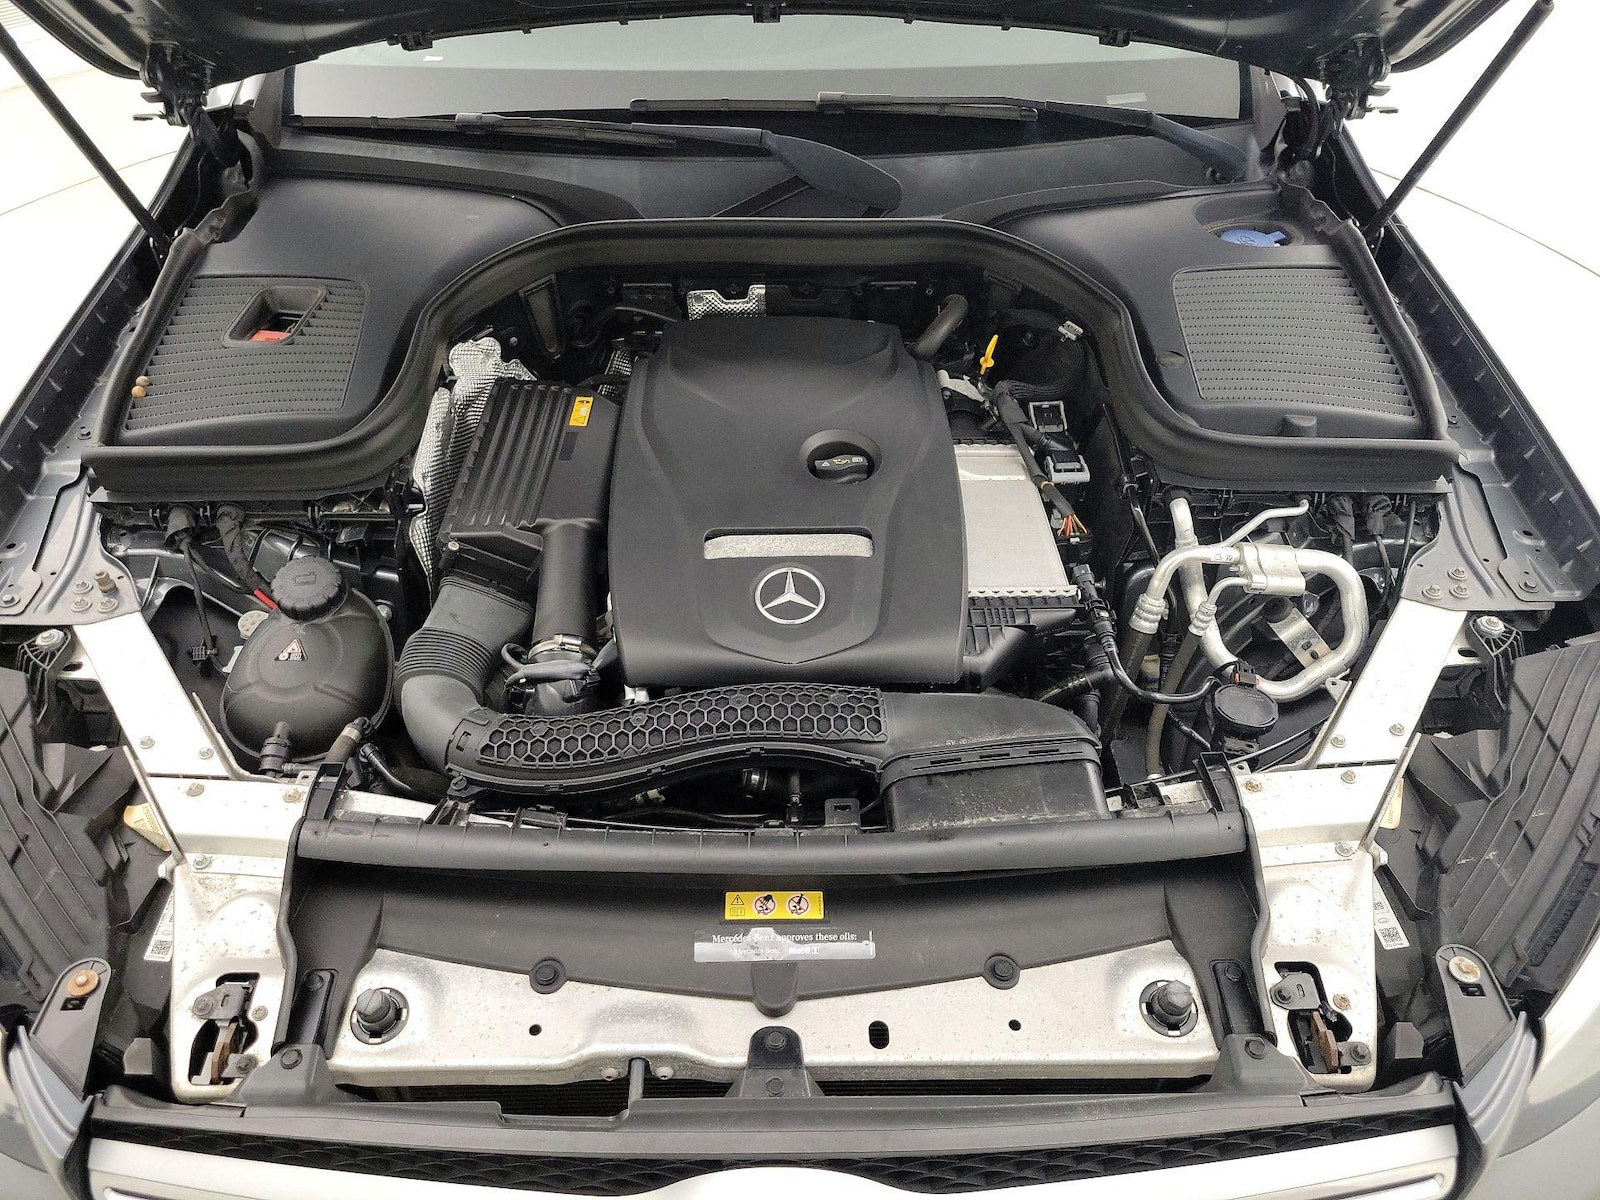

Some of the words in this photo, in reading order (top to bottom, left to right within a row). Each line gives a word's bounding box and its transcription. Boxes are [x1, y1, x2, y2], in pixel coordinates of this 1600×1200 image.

[776, 934, 813, 943] approves
[815, 932, 838, 941] these
[839, 932, 857, 941] oils:
